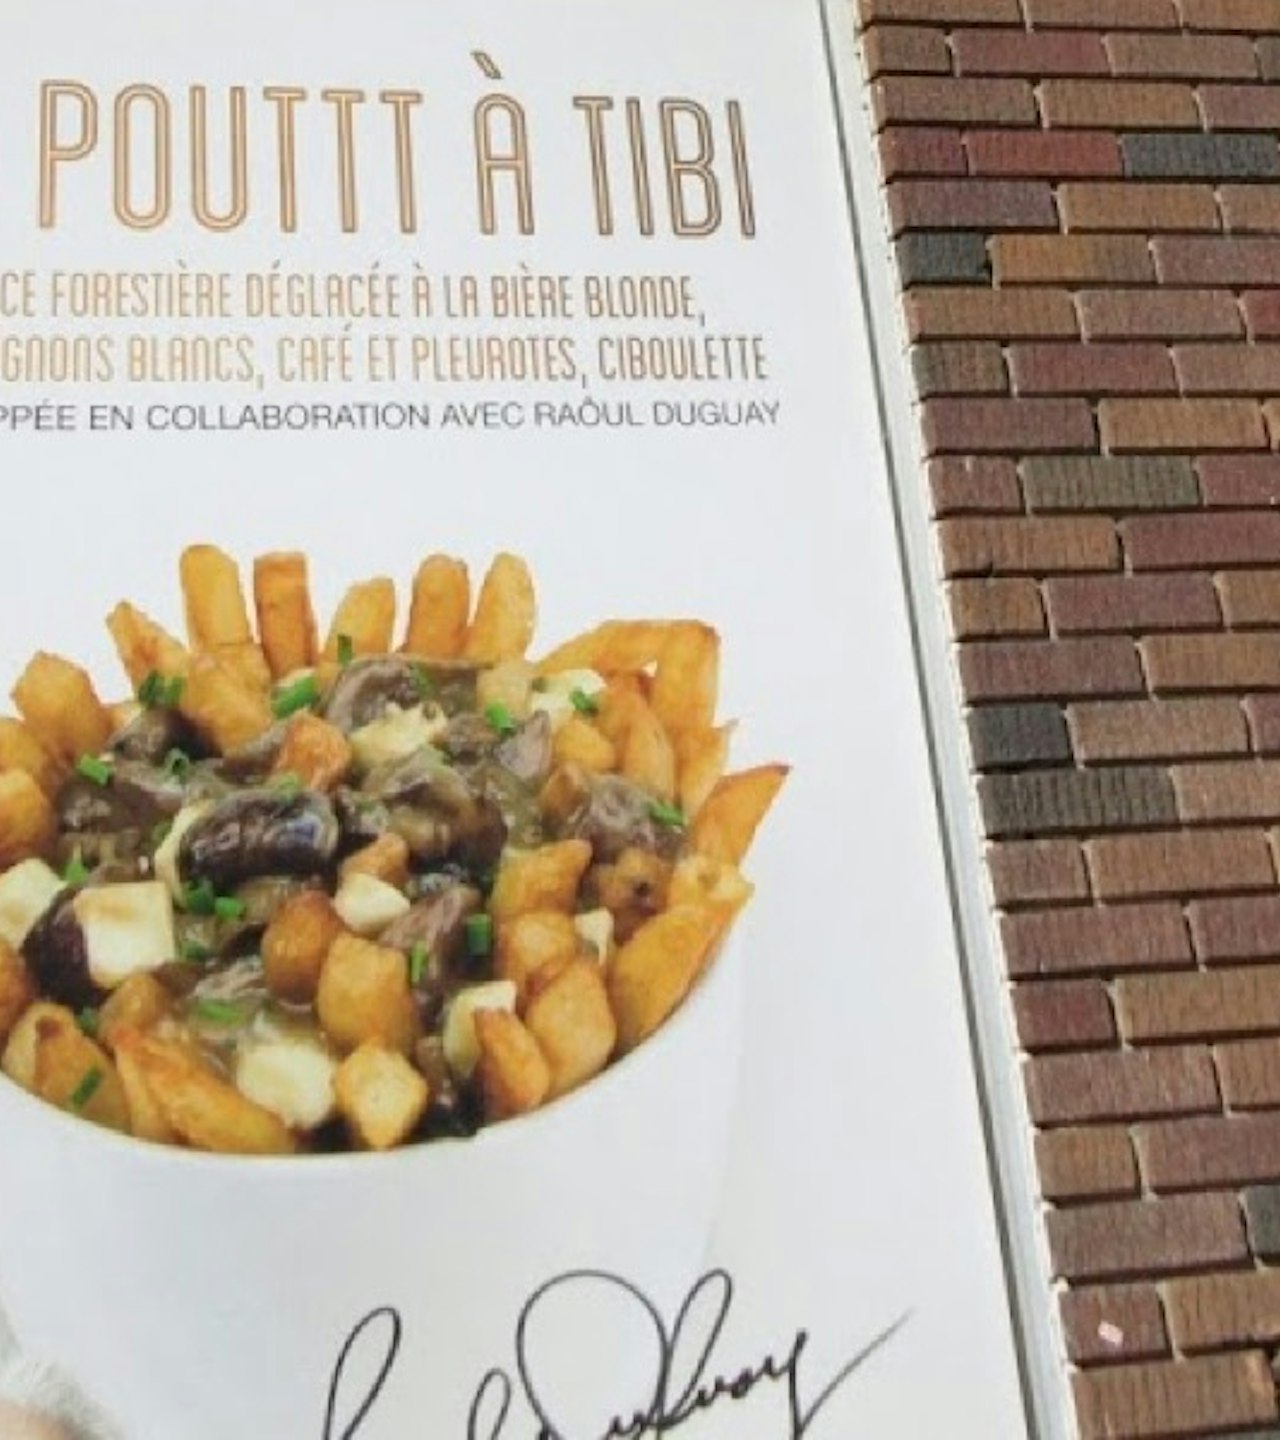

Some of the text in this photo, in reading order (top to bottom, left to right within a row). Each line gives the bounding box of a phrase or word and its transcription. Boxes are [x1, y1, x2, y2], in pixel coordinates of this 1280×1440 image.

[38, 79, 423, 232] POUTTT
[471, 50, 536, 236] À
[572, 94, 757, 239] TIBI
[51, 259, 232, 318] FORESTIÈRE
[246, 259, 402, 319] DÉGLACÉE
[412, 260, 431, 319] À
[444, 274, 480, 319] LA
[490, 260, 574, 319] BIÈRE
[584, 274, 707, 327] BLONDE,
[127, 334, 265, 391] BLANCS,
[277, 322, 353, 383] CAFÉ
[368, 336, 399, 382] ET
[412, 335, 588, 390] PLEUROTES,
[598, 335, 769, 381] CIBOULETTE
[89, 404, 134, 432] EN
[146, 403, 431, 431] COLLABORATION
[440, 403, 524, 429] AVEC
[653, 400, 781, 427] DUGUAY
